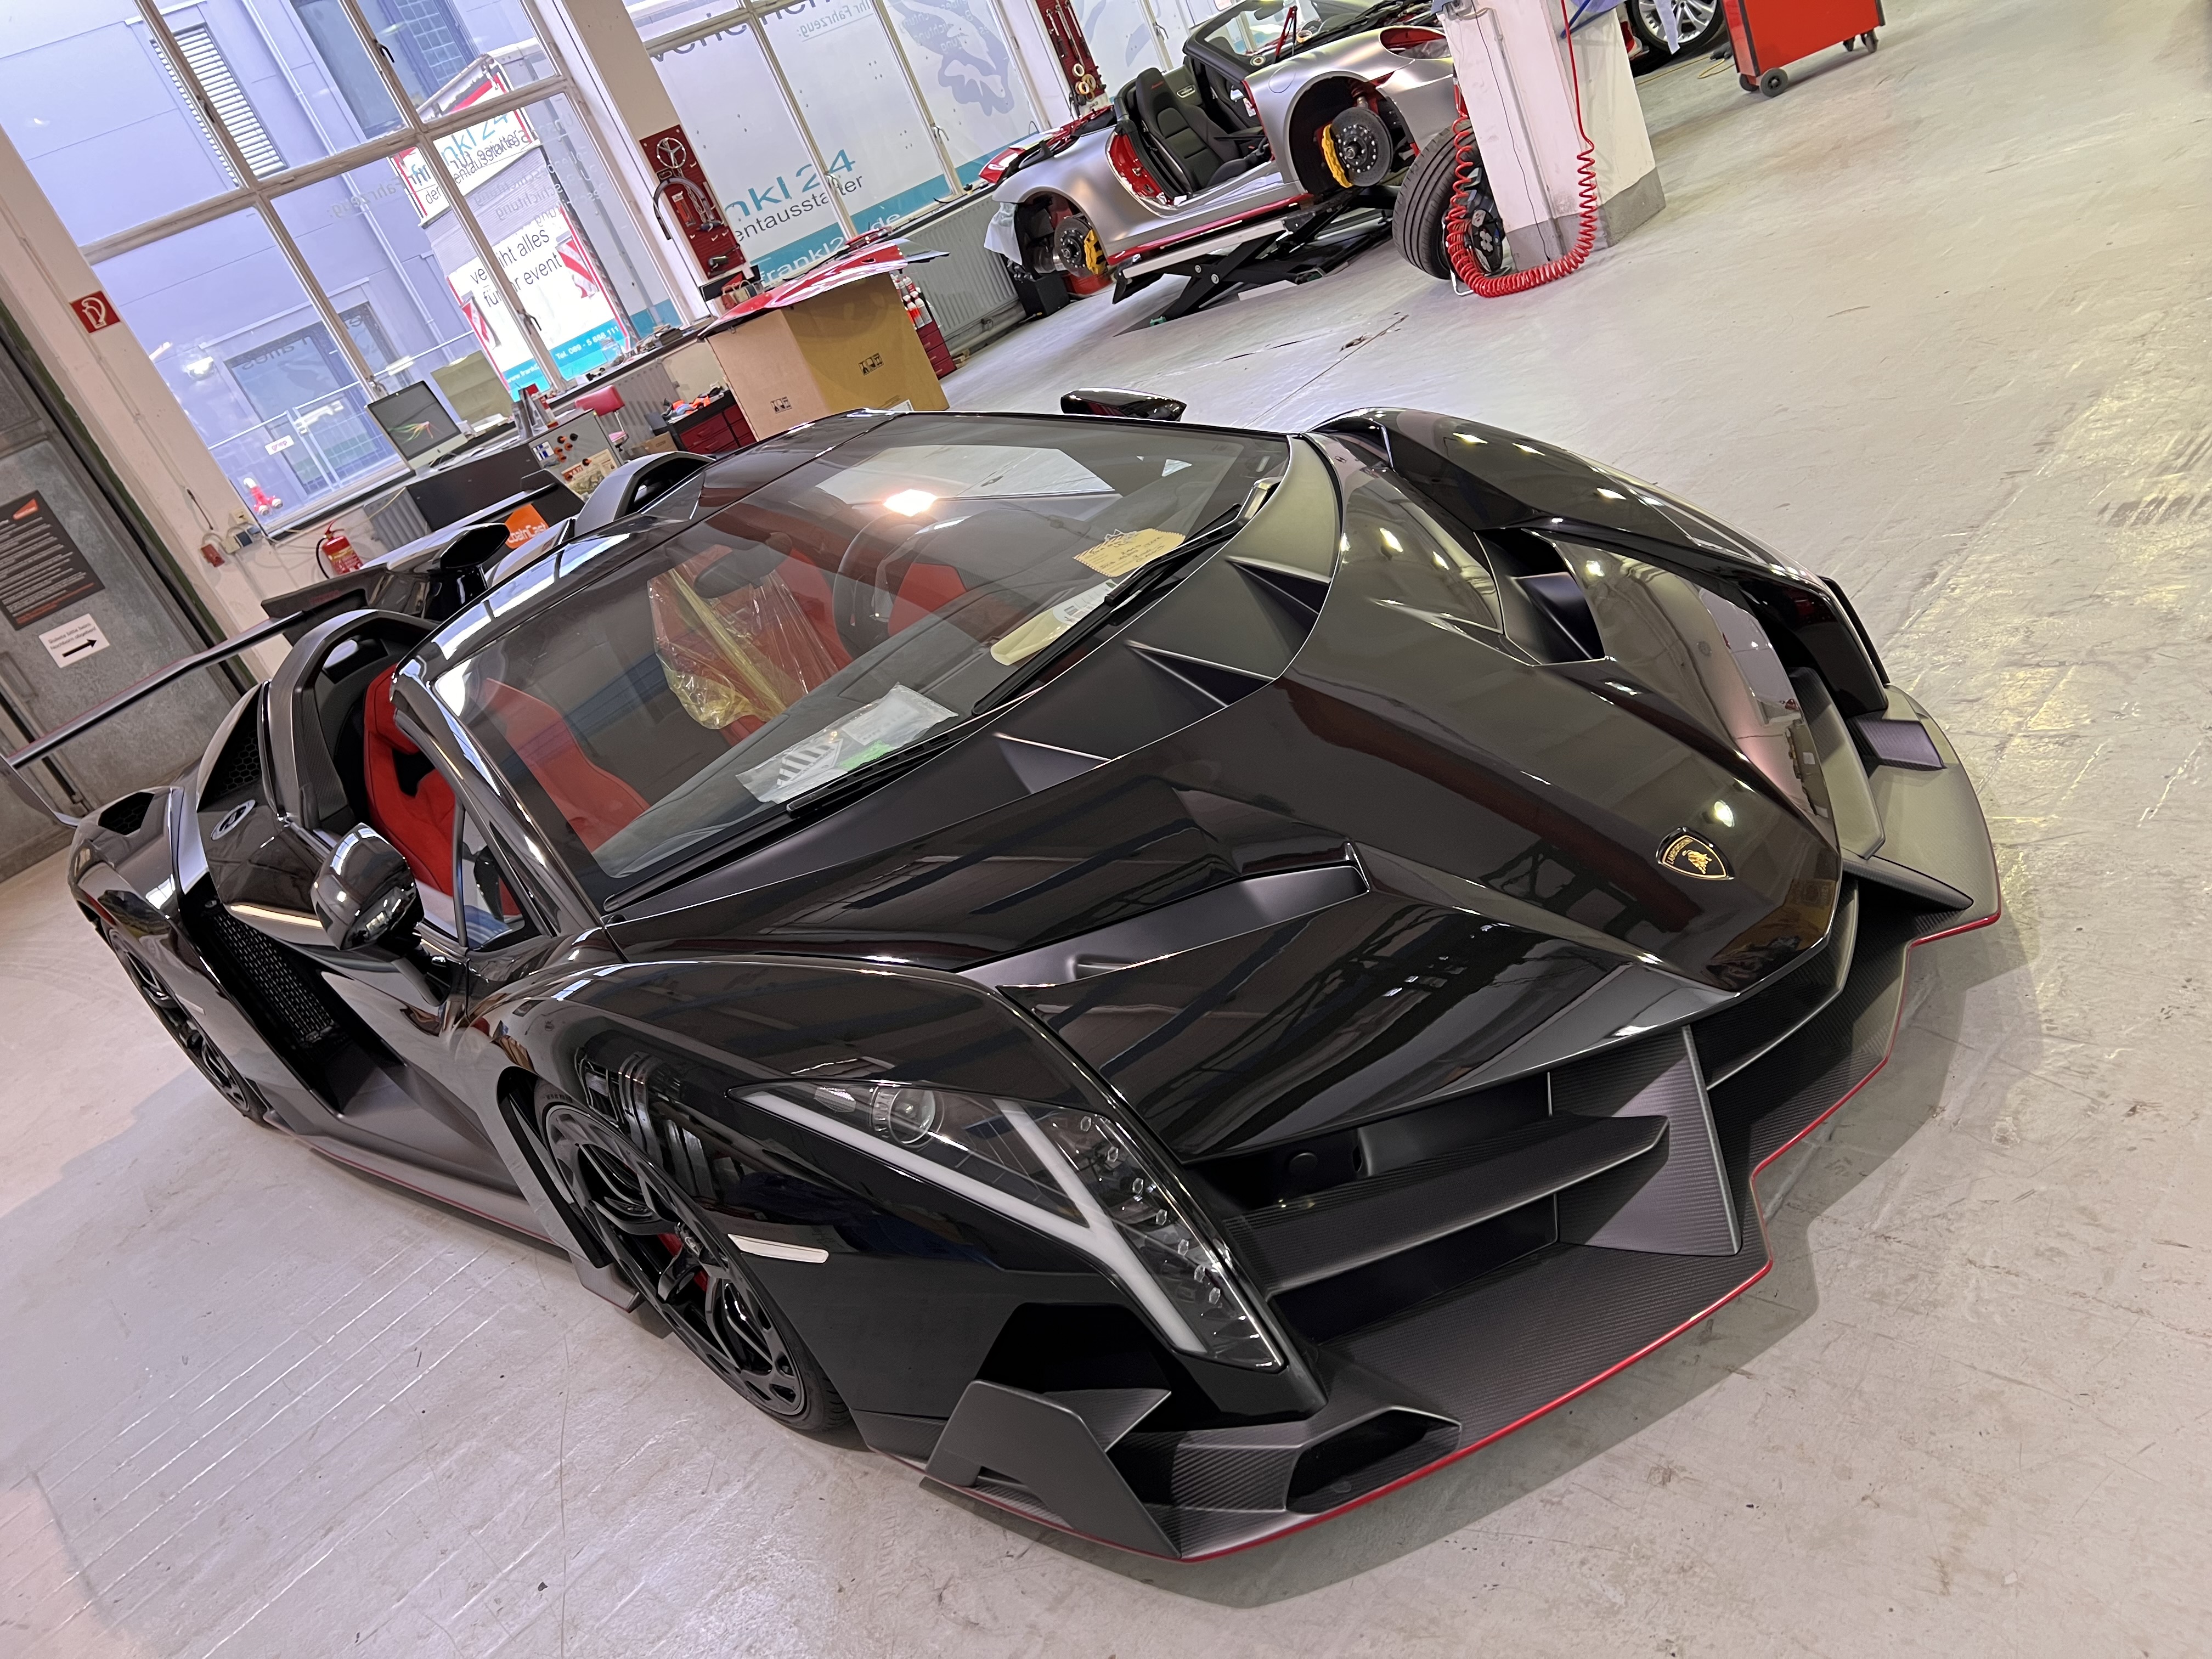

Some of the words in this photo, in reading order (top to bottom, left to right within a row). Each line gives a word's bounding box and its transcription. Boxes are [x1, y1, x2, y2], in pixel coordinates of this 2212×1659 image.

[795, 149, 856, 193] 24
[517, 229, 550, 257] alles
[523, 252, 562, 285] event
[607, 325, 619, 336] 111
